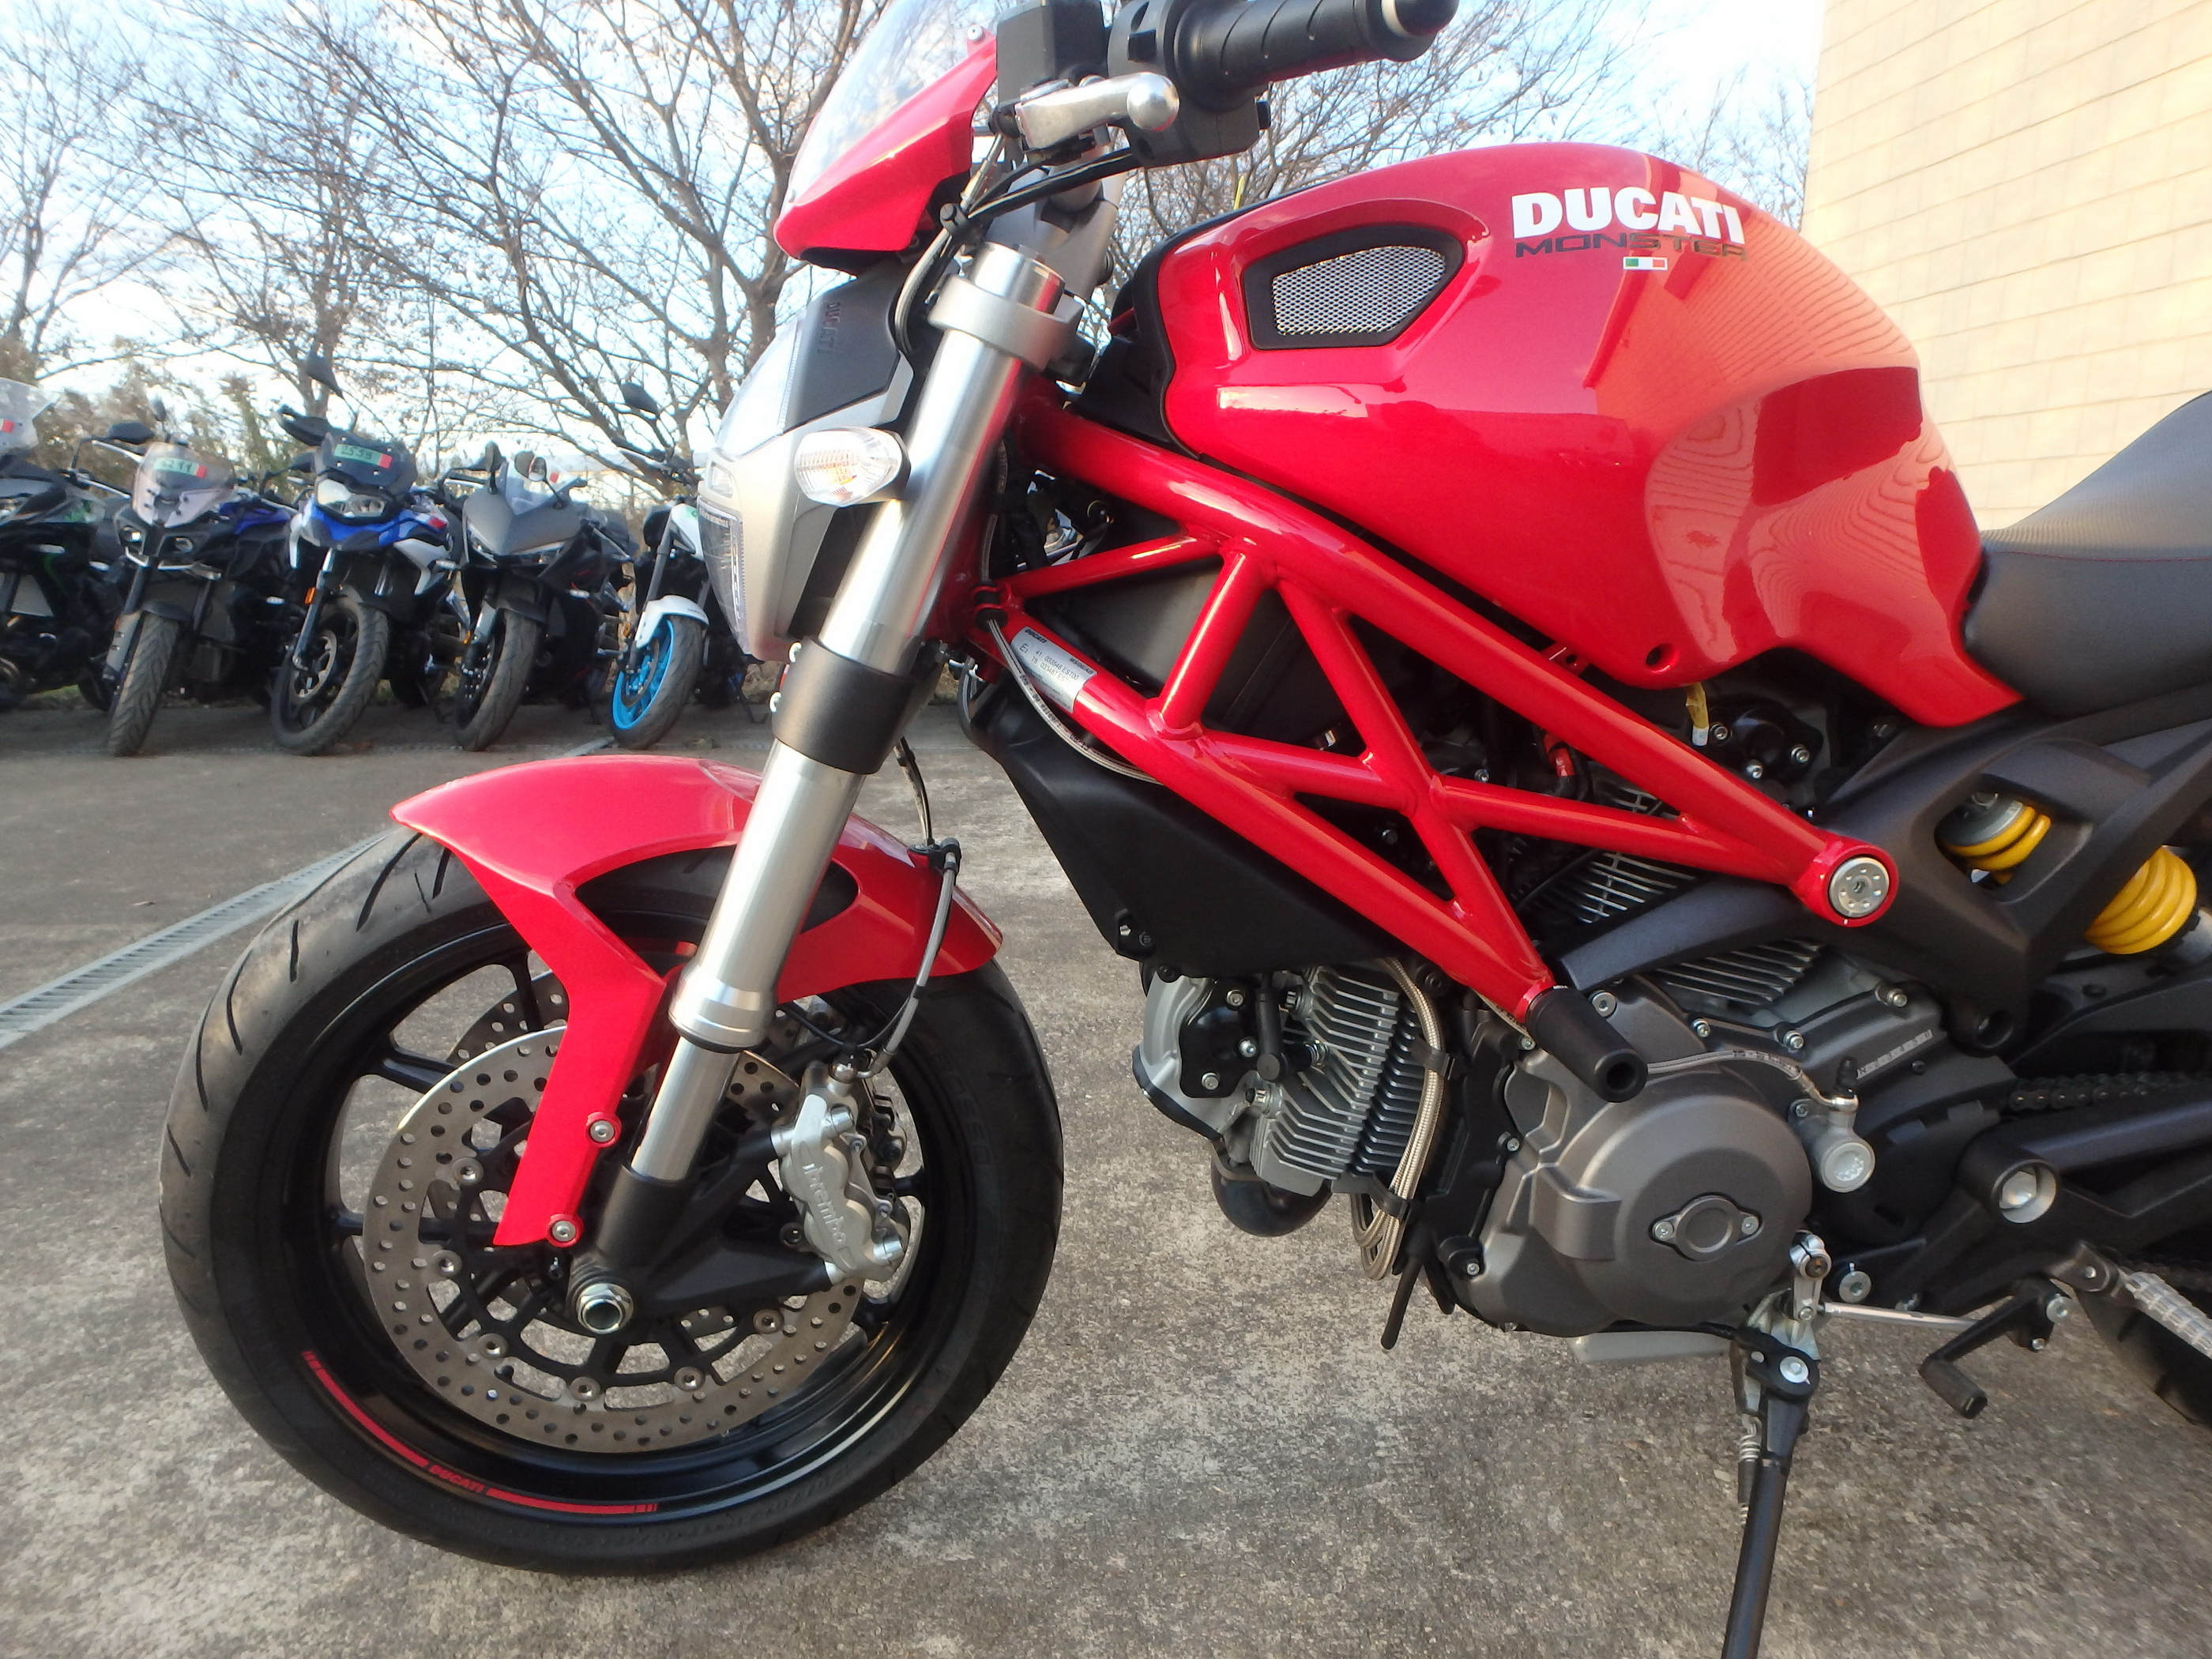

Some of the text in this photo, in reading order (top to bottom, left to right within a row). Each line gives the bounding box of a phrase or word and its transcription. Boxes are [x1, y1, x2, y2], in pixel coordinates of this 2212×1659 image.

[1511, 186, 1745, 245] DUCATI
[1515, 232, 1749, 261] MONSTER
[1025, 628, 1048, 644] DUCATI
[804, 1165, 847, 1244] brembo
[429, 1464, 486, 1493] DUCATI
